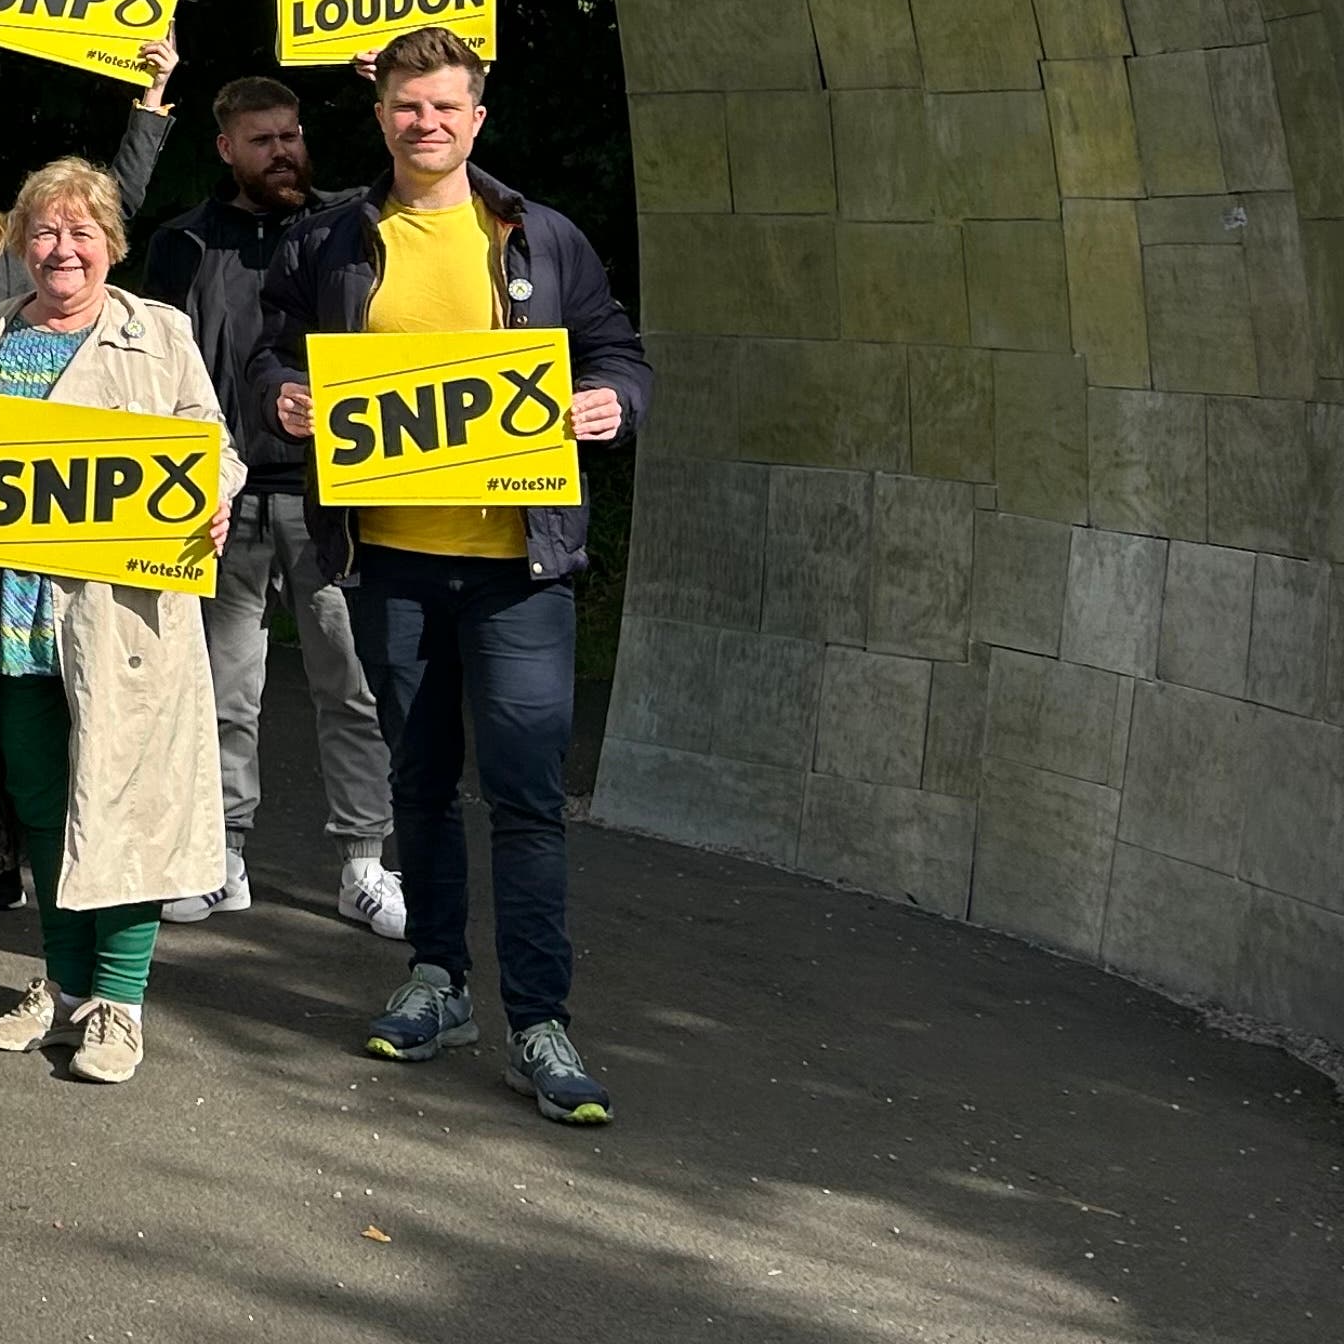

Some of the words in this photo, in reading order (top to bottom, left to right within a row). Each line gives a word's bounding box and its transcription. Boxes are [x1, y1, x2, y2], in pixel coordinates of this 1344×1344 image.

[329, 377, 493, 466] SNP
[486, 477, 567, 492] #VoteSNP
[125, 558, 204, 581] #VoteSNP
